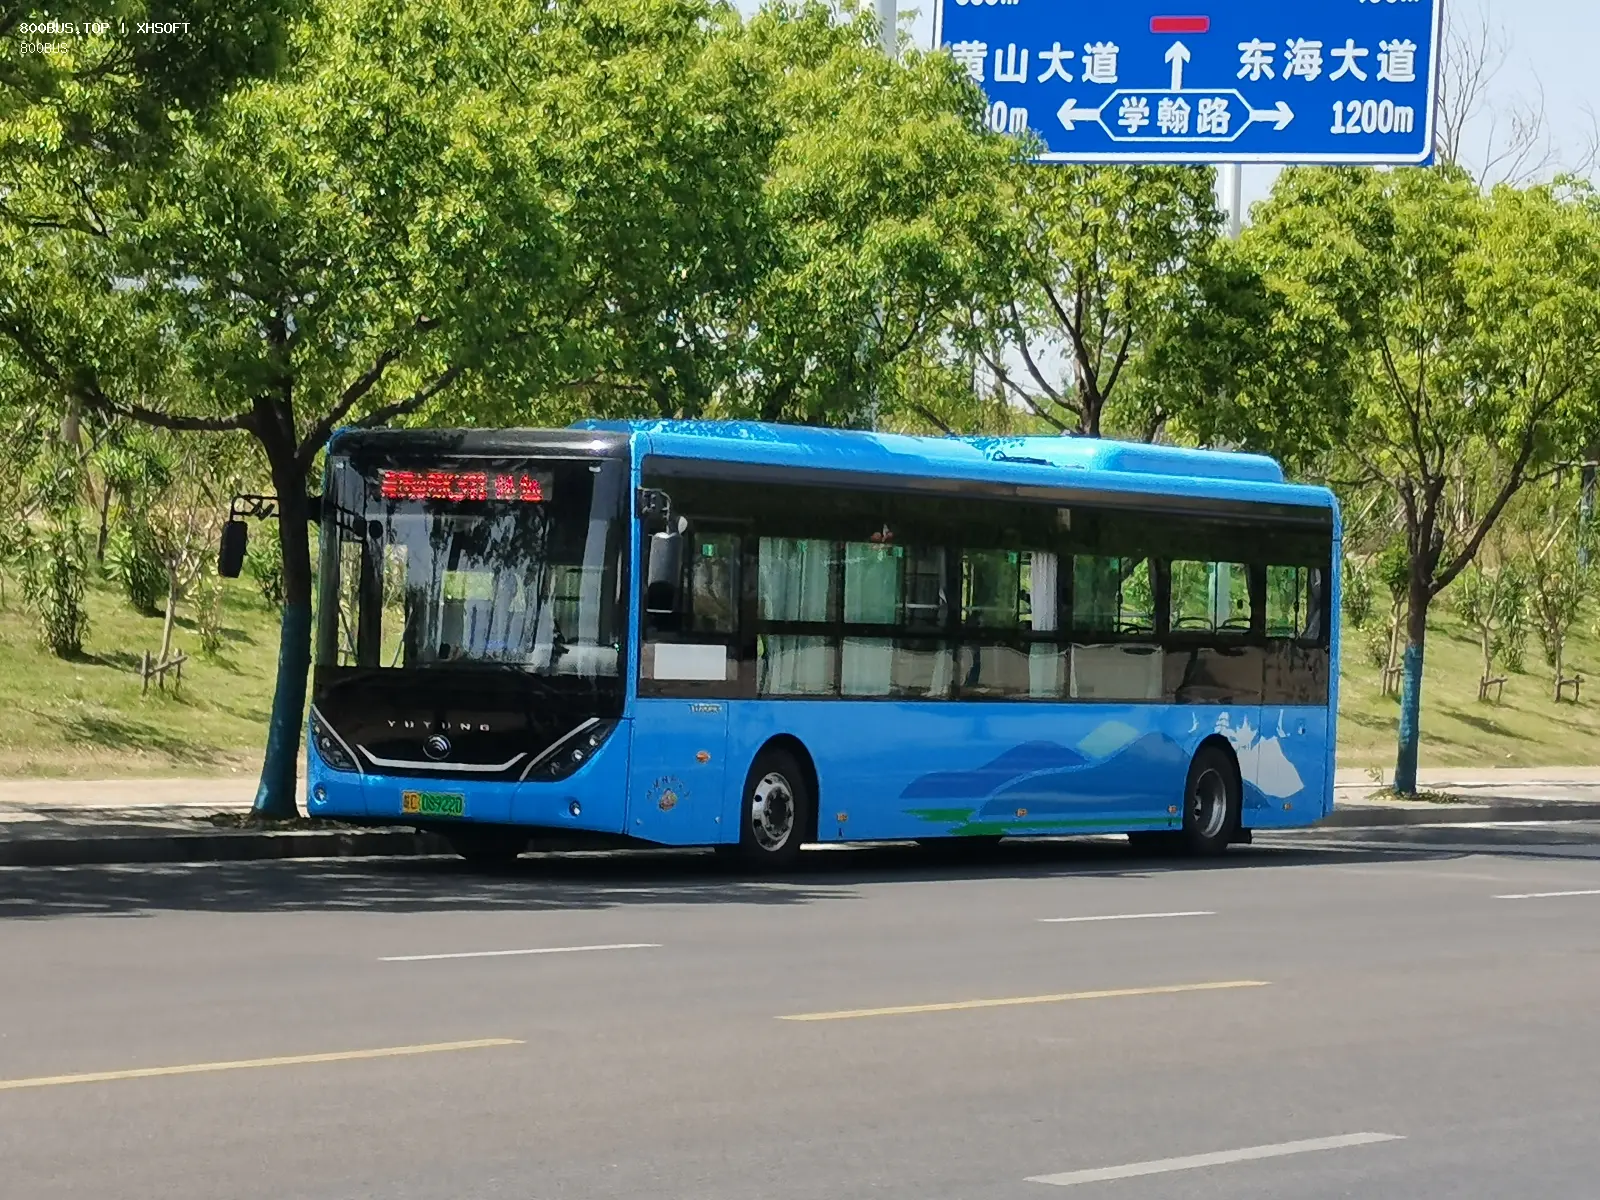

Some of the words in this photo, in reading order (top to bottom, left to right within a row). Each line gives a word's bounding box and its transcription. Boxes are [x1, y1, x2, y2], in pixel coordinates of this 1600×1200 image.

[952, 40, 1119, 84] 黄山大道
[1237, 38, 1417, 83] 东海大道
[1116, 96, 1231, 135] 学翰路
[1330, 99, 1414, 135] 1200m
